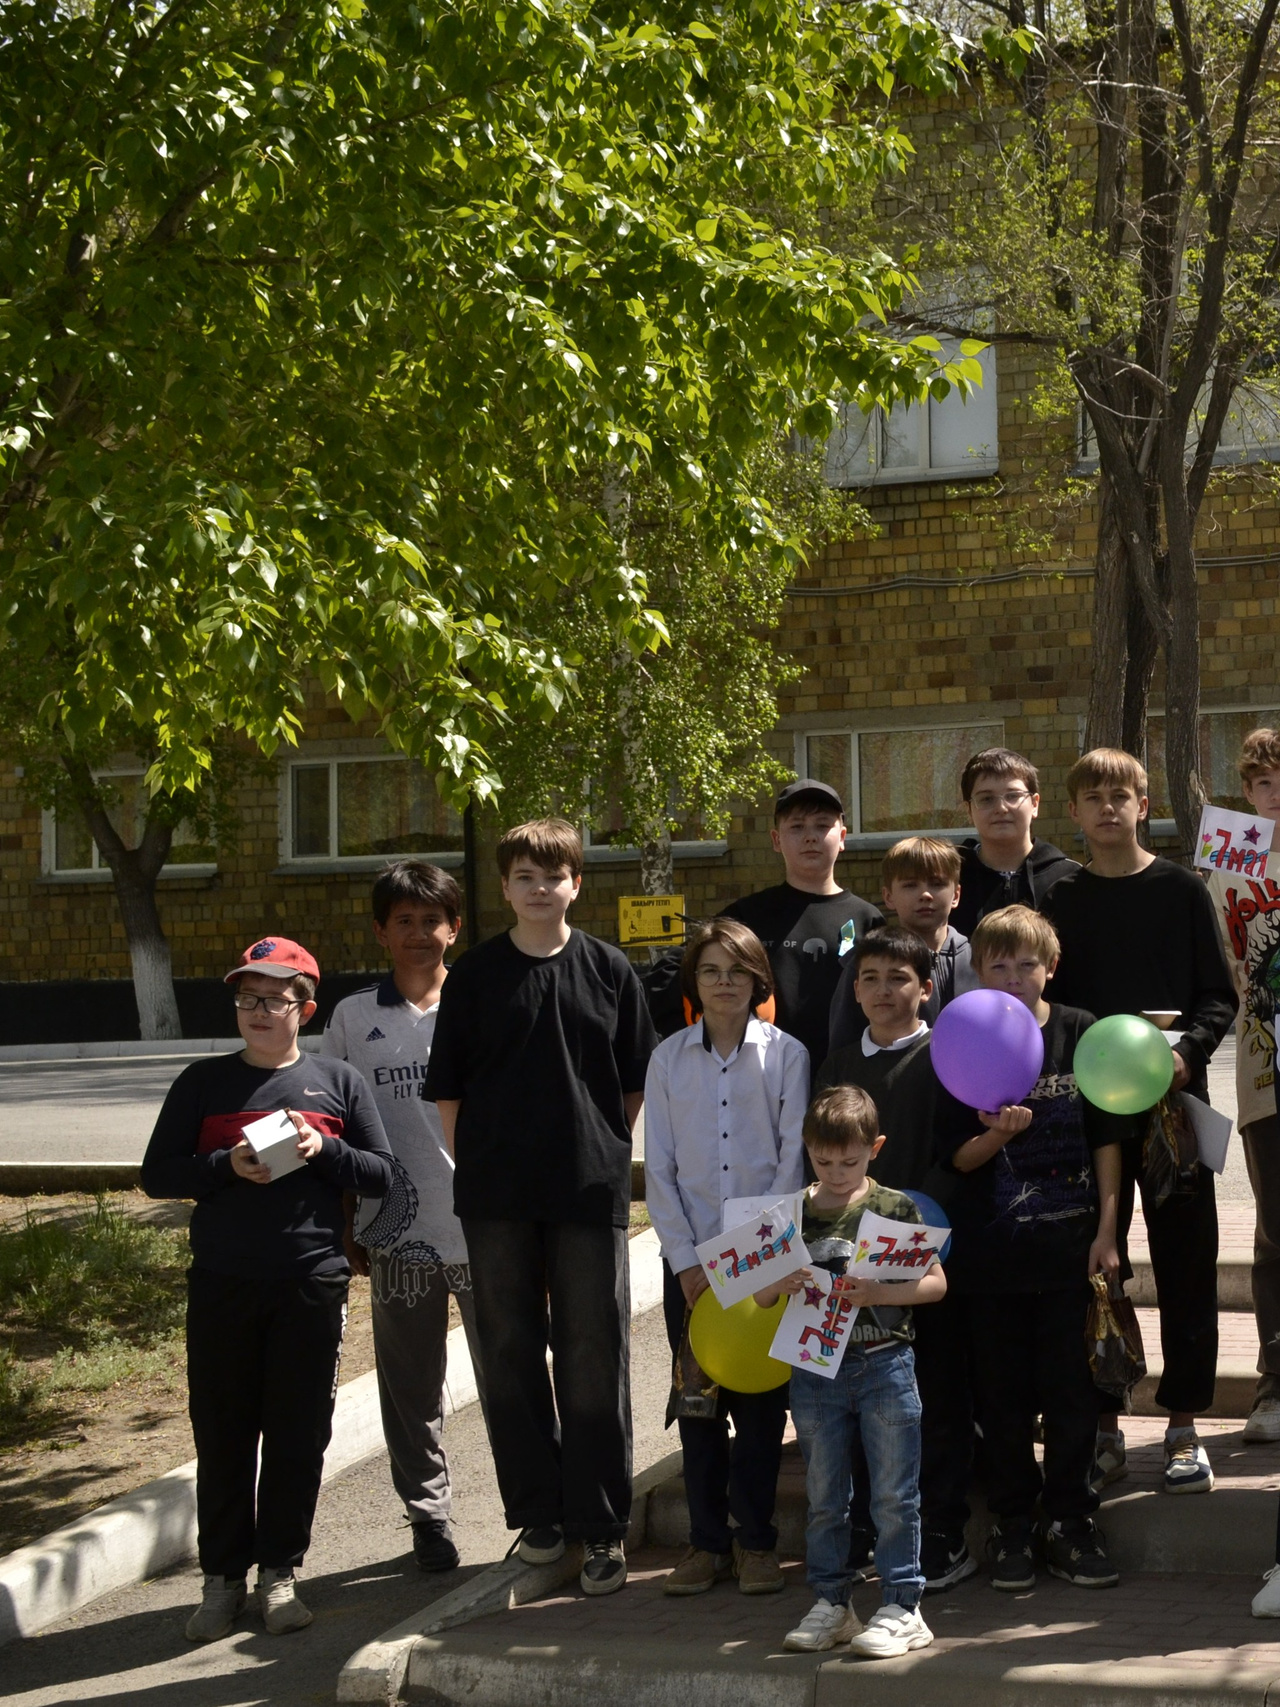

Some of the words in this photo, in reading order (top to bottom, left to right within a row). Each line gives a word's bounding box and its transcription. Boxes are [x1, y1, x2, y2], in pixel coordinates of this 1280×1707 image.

[1215, 828, 1231, 868] 7
[783, 940, 797, 948] OF
[373, 1061, 428, 1086] Emir
[394, 1083, 412, 1099] FLY
[719, 1248, 740, 1278] 7
[876, 1236, 897, 1266] 7
[851, 1324, 890, 1342] ORLD
